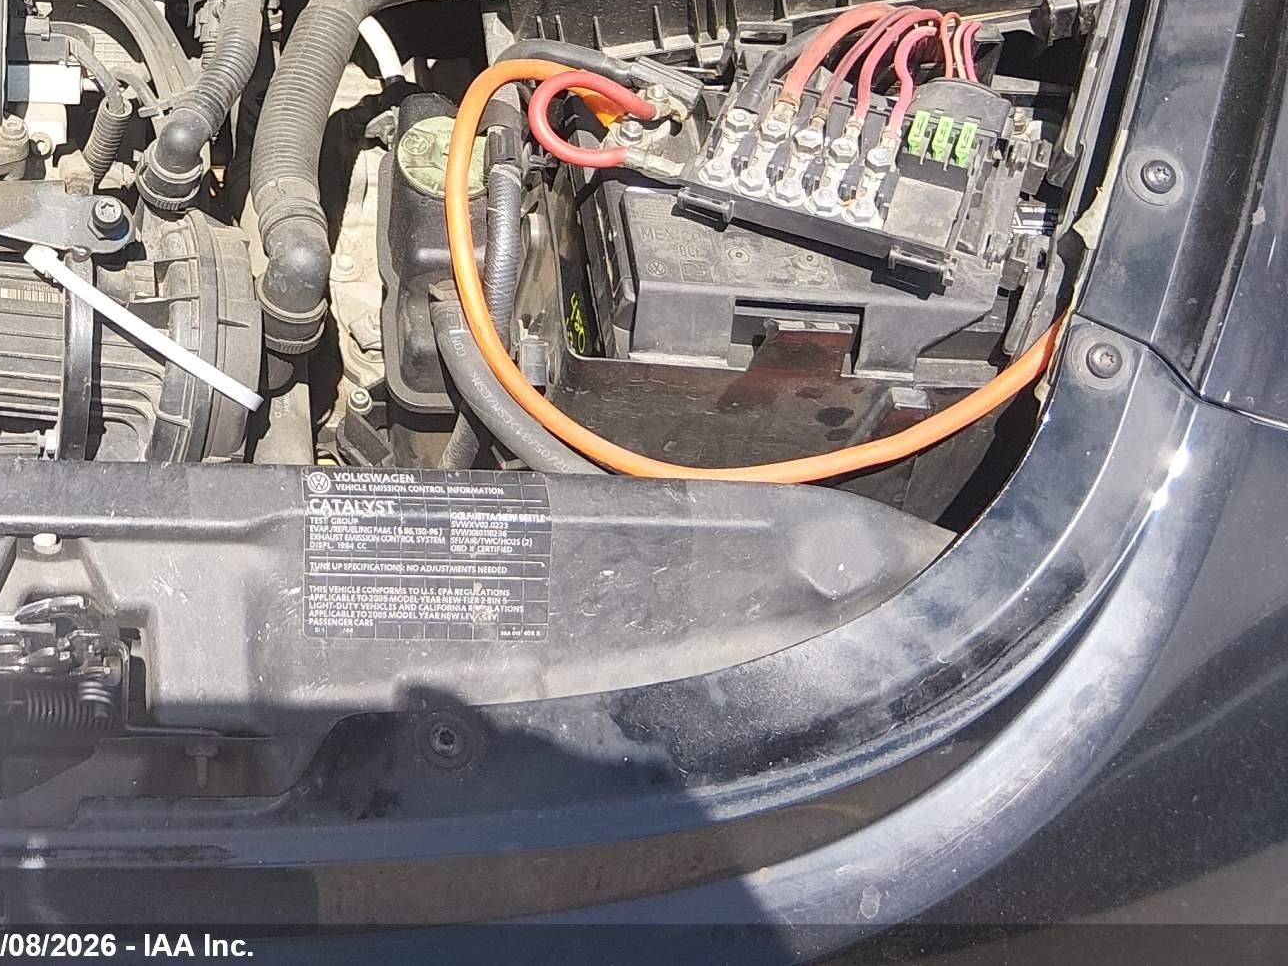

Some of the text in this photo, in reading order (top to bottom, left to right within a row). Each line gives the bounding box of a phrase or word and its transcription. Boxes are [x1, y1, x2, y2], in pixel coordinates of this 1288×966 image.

[333, 471, 416, 483] VOLKSWAGEN
[335, 483, 505, 495] VEHICLE EMISSION CONTROL INFORMATION
[309, 498, 396, 515] CATALYST
[310, 516, 359, 525] TEST GROUP
[309, 533, 446, 545] EXHAUST EMISSION CONTROL SYSTEM
[521, 538, 533, 548] (2)
[309, 541, 368, 550] DISPL. 1984 CC
[450, 545, 468, 553] OBD
[476, 545, 513, 554] CERTIFIED
[309, 561, 331, 571] TUNE
[331, 562, 343, 571] UP
[406, 564, 420, 573] NO
[420, 564, 476, 574] ADJUSTMENTS
[477, 566, 508, 574] NEEDED
[309, 585, 511, 597] THIS VEHICLE CONFORMS TO U.S. EPA REGULATIONS
[309, 593, 356, 602] APPLICABLE
[357, 594, 368, 602] TO
[368, 594, 389, 603] 2005
[389, 595, 418, 603] MODEL
[419, 595, 442, 604] YEAR
[442, 596, 462, 604] NEW
[462, 596, 481, 604] TIER
[488, 597, 502, 605] BIN
[309, 601, 525, 614] LIGHT-DUTY VEHICLES AND CALIFORNIA RLATIONS
[308, 609, 461, 621] APPLICABLE TO 2005 MODEL YEAR NEW
[308, 617, 374, 626] PASSENGER CARS
